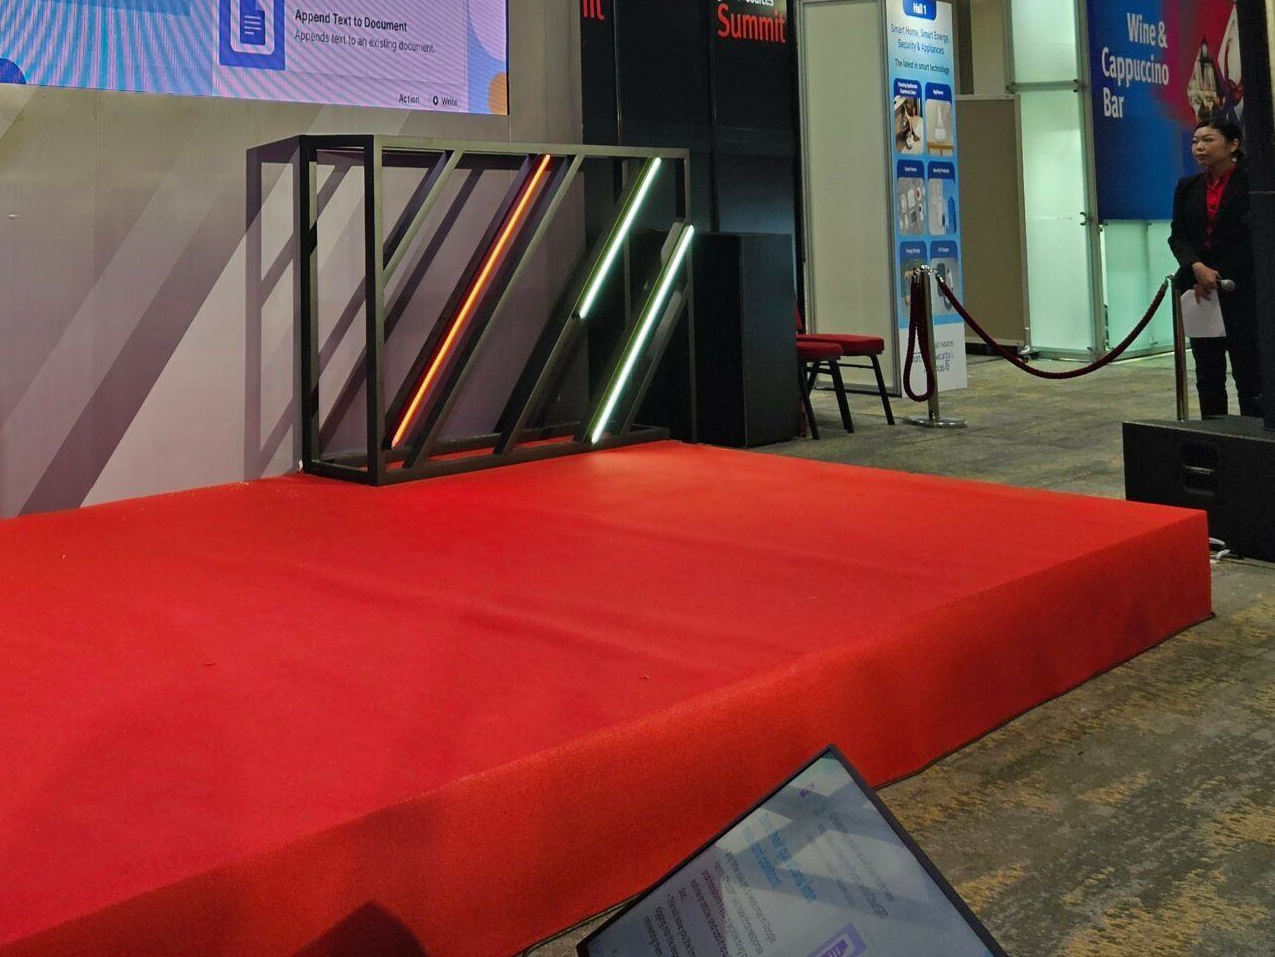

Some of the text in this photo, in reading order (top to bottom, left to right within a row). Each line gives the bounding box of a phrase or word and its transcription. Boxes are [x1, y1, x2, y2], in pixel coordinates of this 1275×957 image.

[295, 9, 407, 33] Append Text to Document
[717, 3, 786, 43] Summit
[1126, 12, 1169, 49] Wine &
[294, 29, 329, 46] Appends
[331, 34, 347, 45] text
[348, 35, 356, 46] to
[357, 38, 367, 47] an
[368, 37, 397, 53] existing
[1101, 46, 1170, 88] Cappuccino
[1103, 86, 1125, 119] Bar
